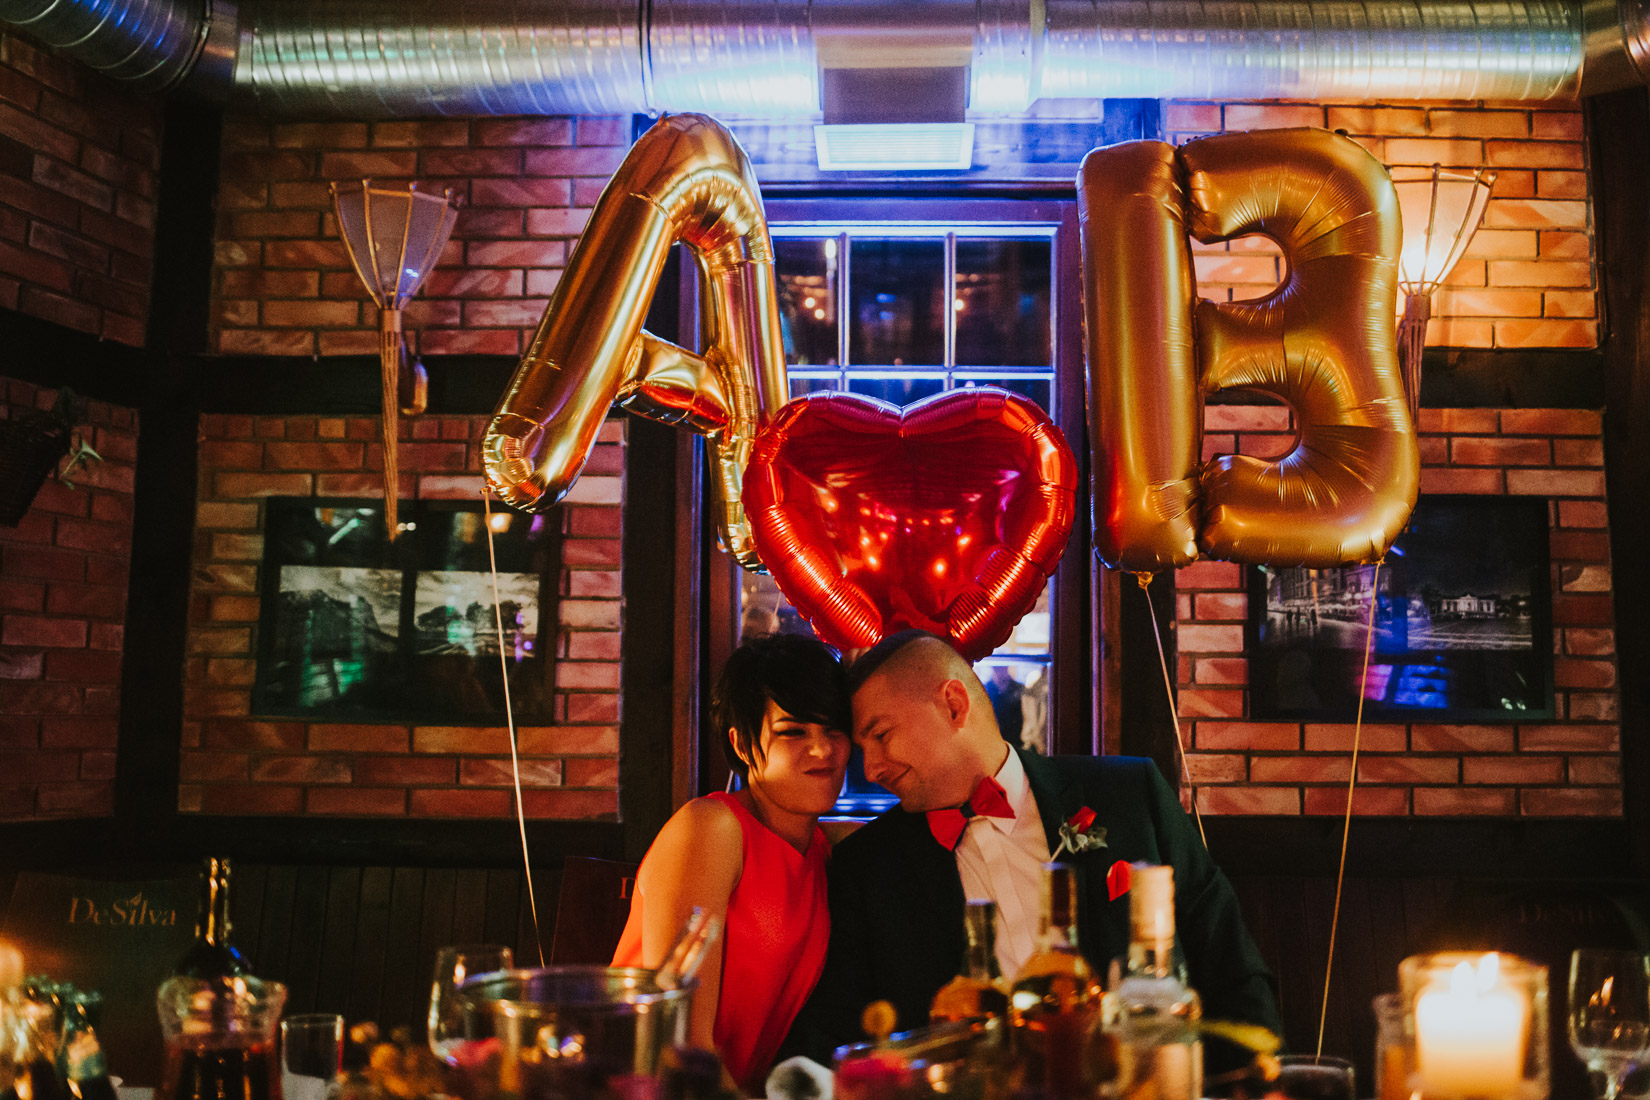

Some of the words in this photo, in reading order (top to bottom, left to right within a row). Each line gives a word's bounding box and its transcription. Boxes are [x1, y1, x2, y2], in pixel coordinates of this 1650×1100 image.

[481, 112, 788, 572] A
[1076, 127, 1420, 571] B
[68, 892, 177, 926] DeSilva
[1518, 903, 1617, 925] DeSilv
